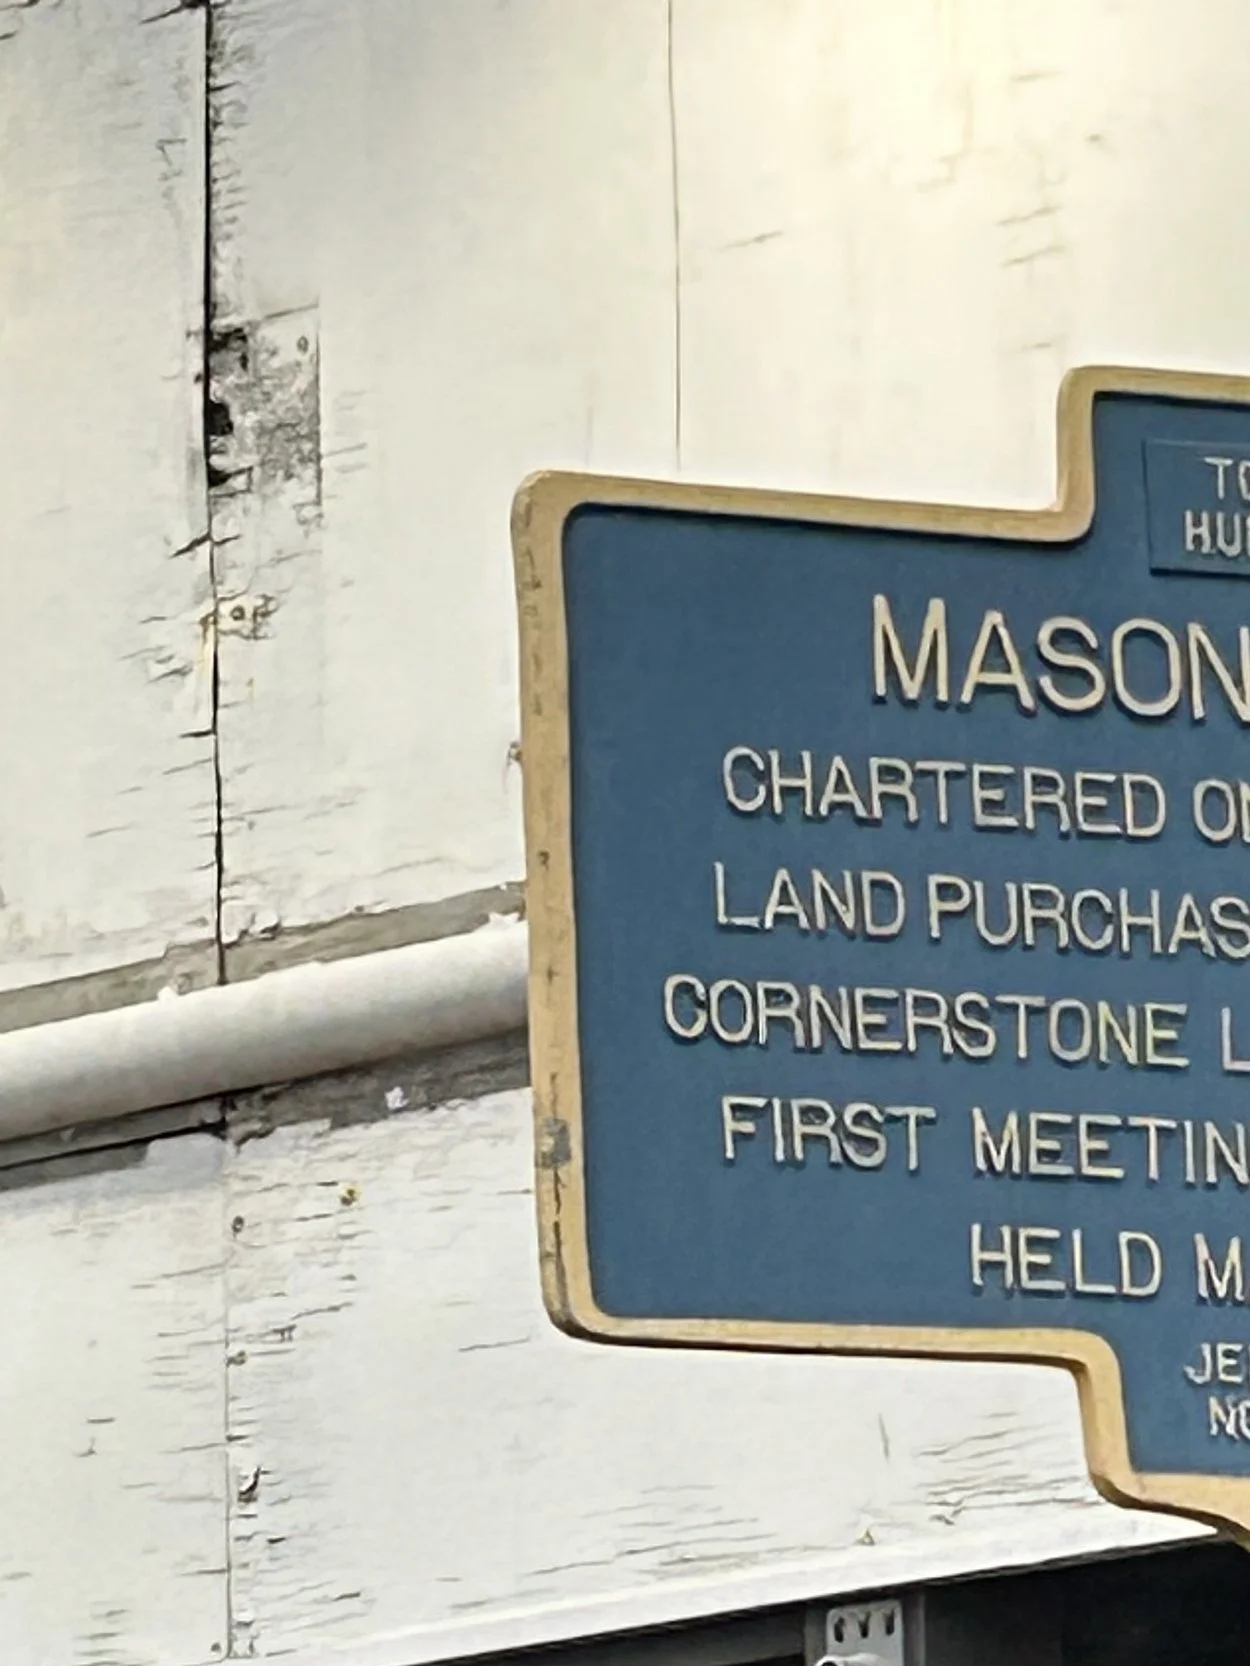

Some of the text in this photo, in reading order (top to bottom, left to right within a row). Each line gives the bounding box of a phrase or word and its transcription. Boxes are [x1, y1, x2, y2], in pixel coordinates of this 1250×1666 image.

[722, 745, 1167, 838] CHARTERED
[713, 860, 906, 936] LAND
[663, 973, 1191, 1068] CORNERSTONE
[720, 1094, 937, 1171] FIRST
[970, 1222, 1163, 1297] HELD
